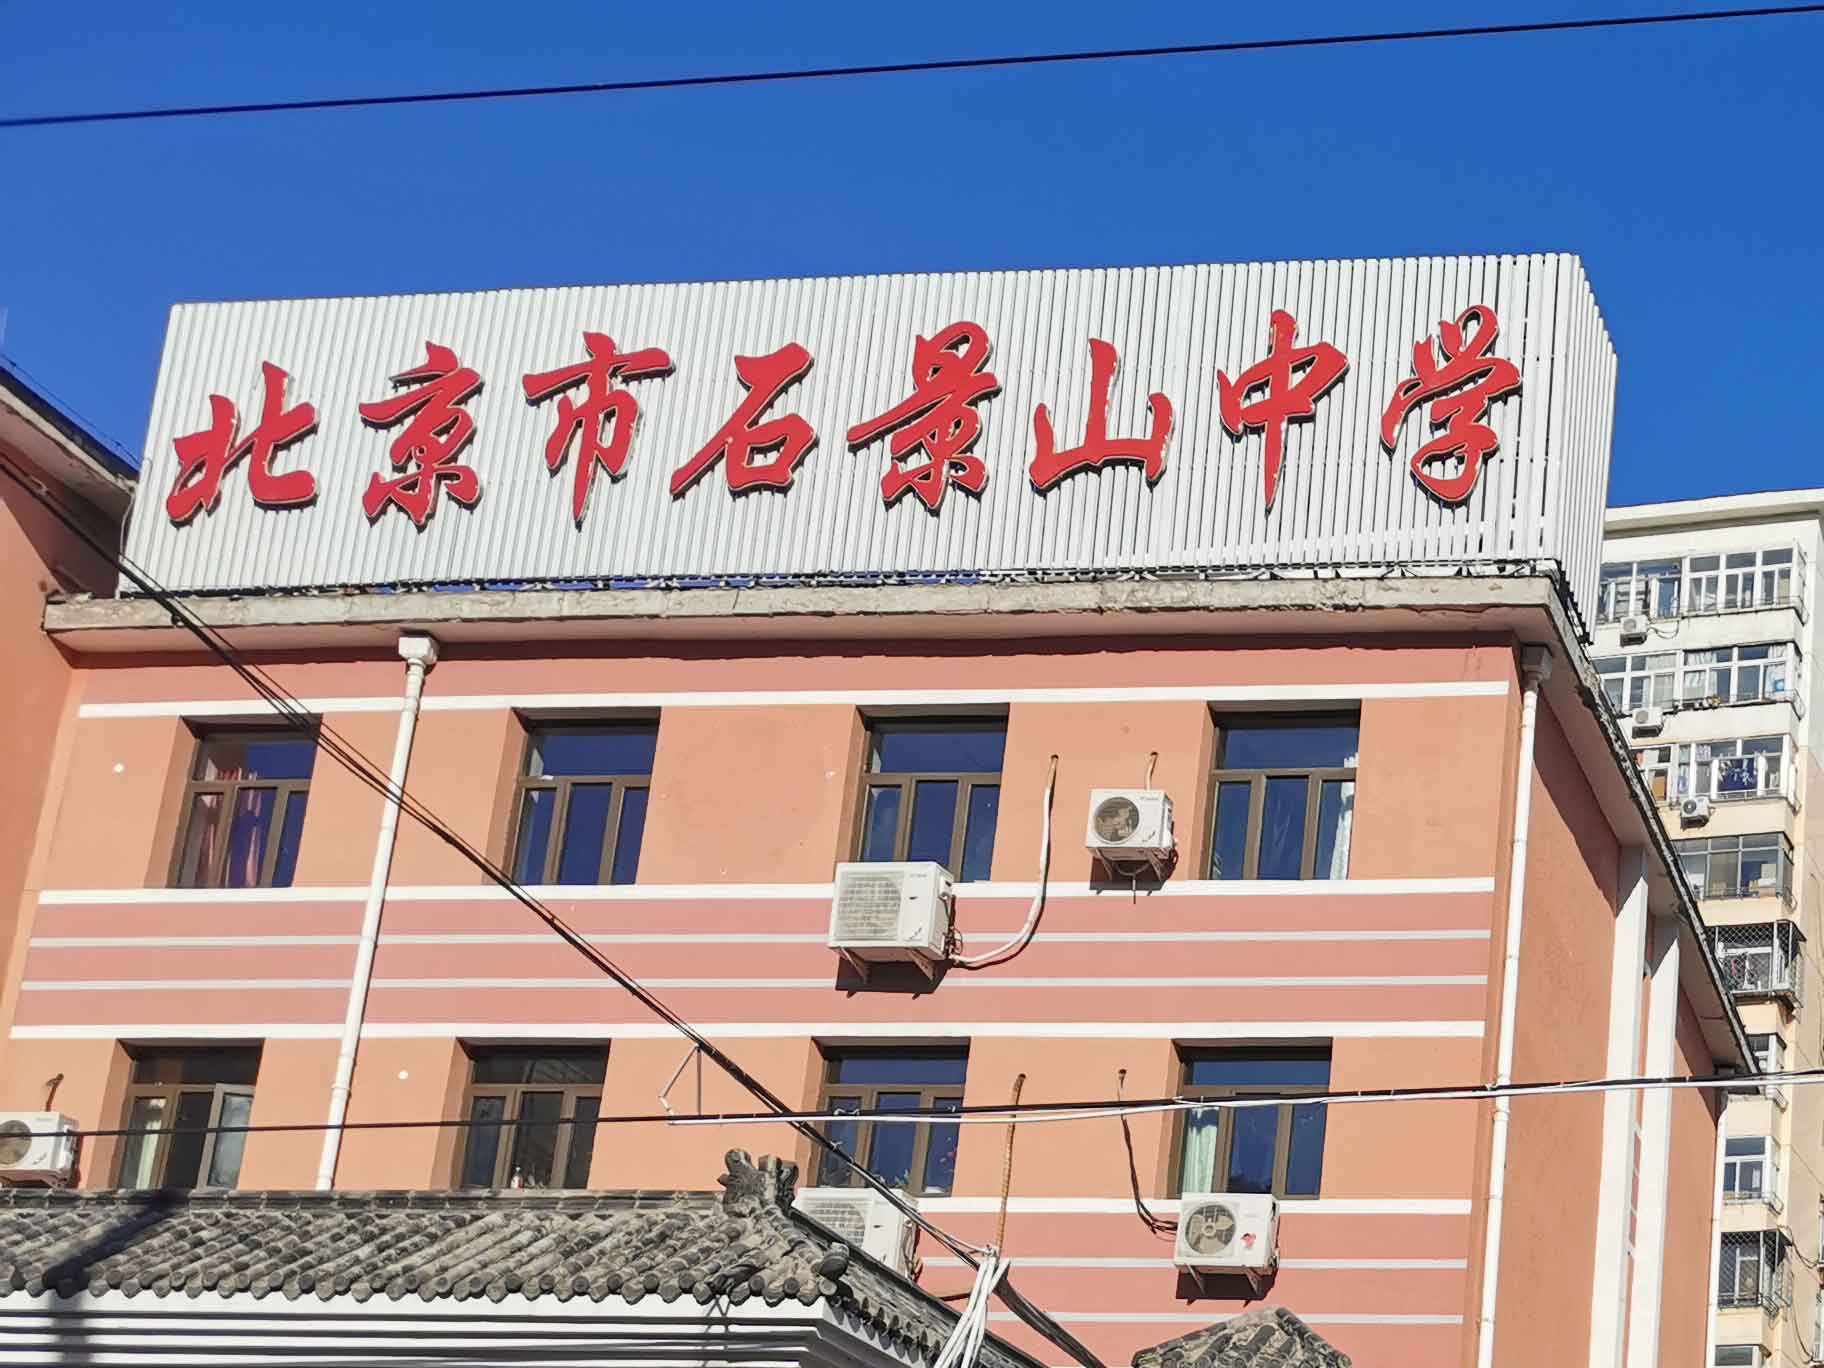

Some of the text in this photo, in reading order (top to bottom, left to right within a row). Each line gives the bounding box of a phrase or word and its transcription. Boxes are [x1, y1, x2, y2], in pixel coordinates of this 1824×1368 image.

[166, 304, 1521, 525] 北京市石景山中学
